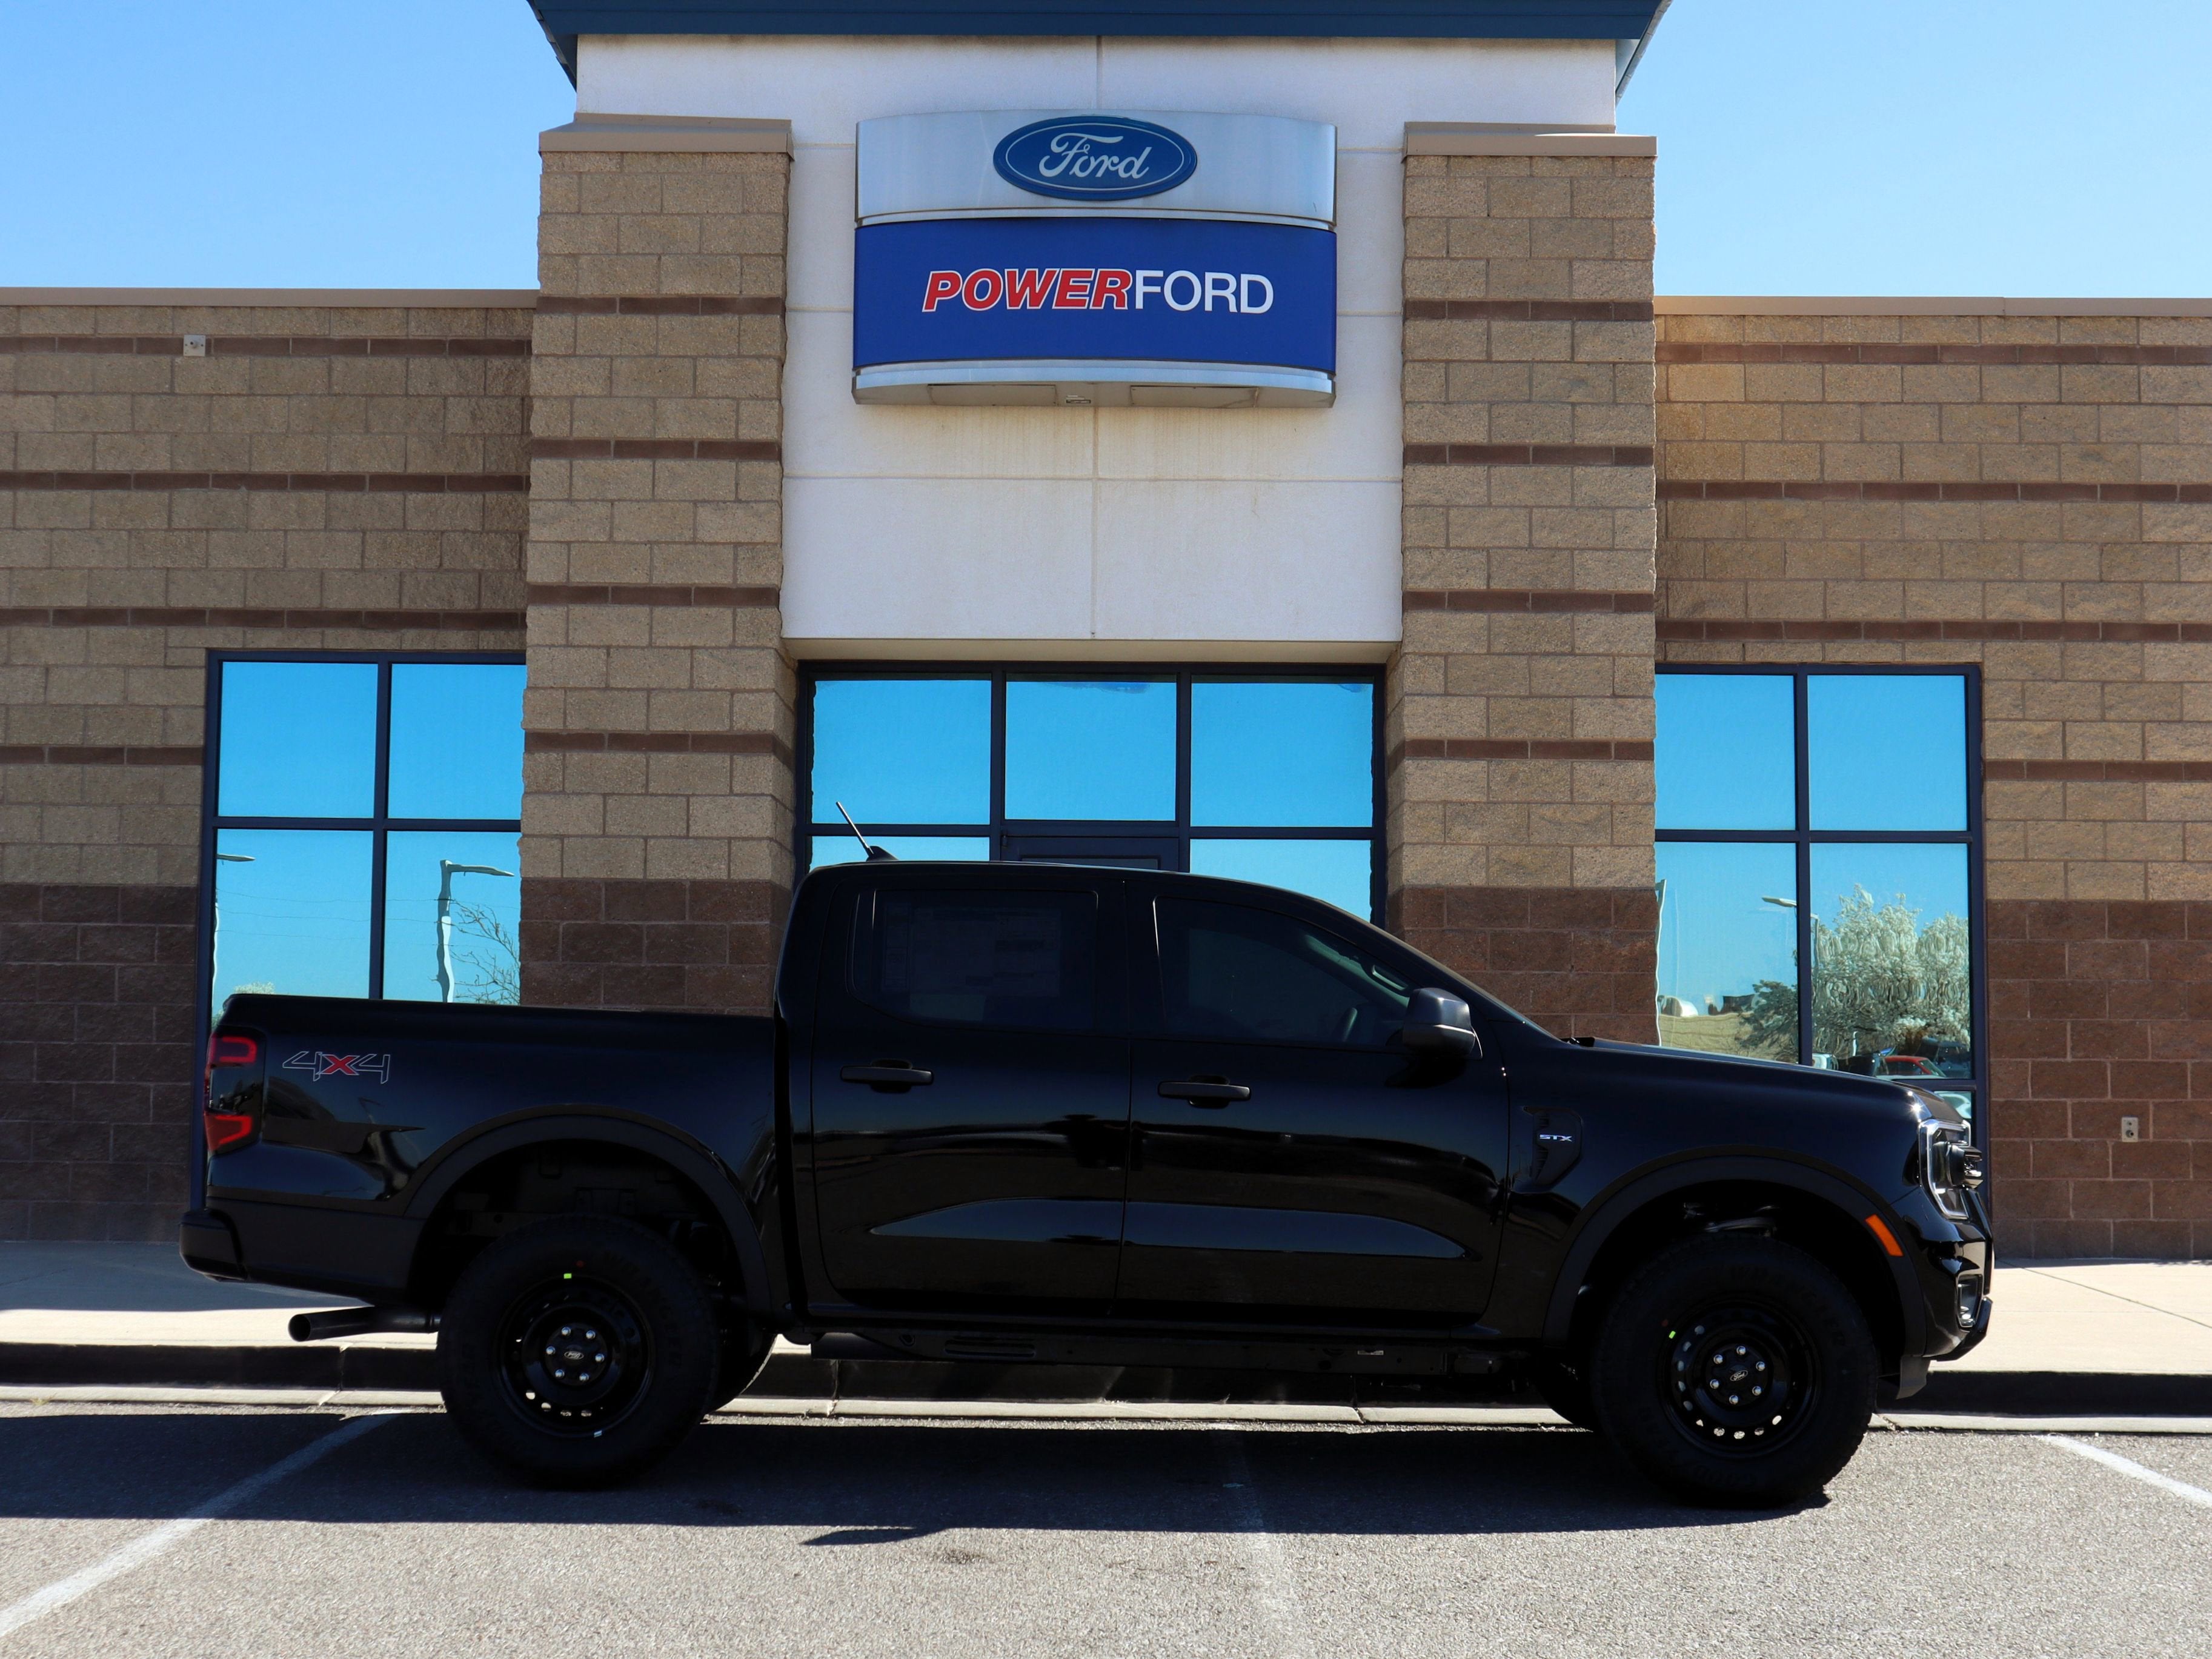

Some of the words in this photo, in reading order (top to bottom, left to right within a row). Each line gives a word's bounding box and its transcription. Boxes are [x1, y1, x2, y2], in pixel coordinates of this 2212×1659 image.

[1038, 132, 1152, 179] Ford
[922, 268, 1275, 314] POWERFORD
[1539, 1134, 1573, 1142] STX
